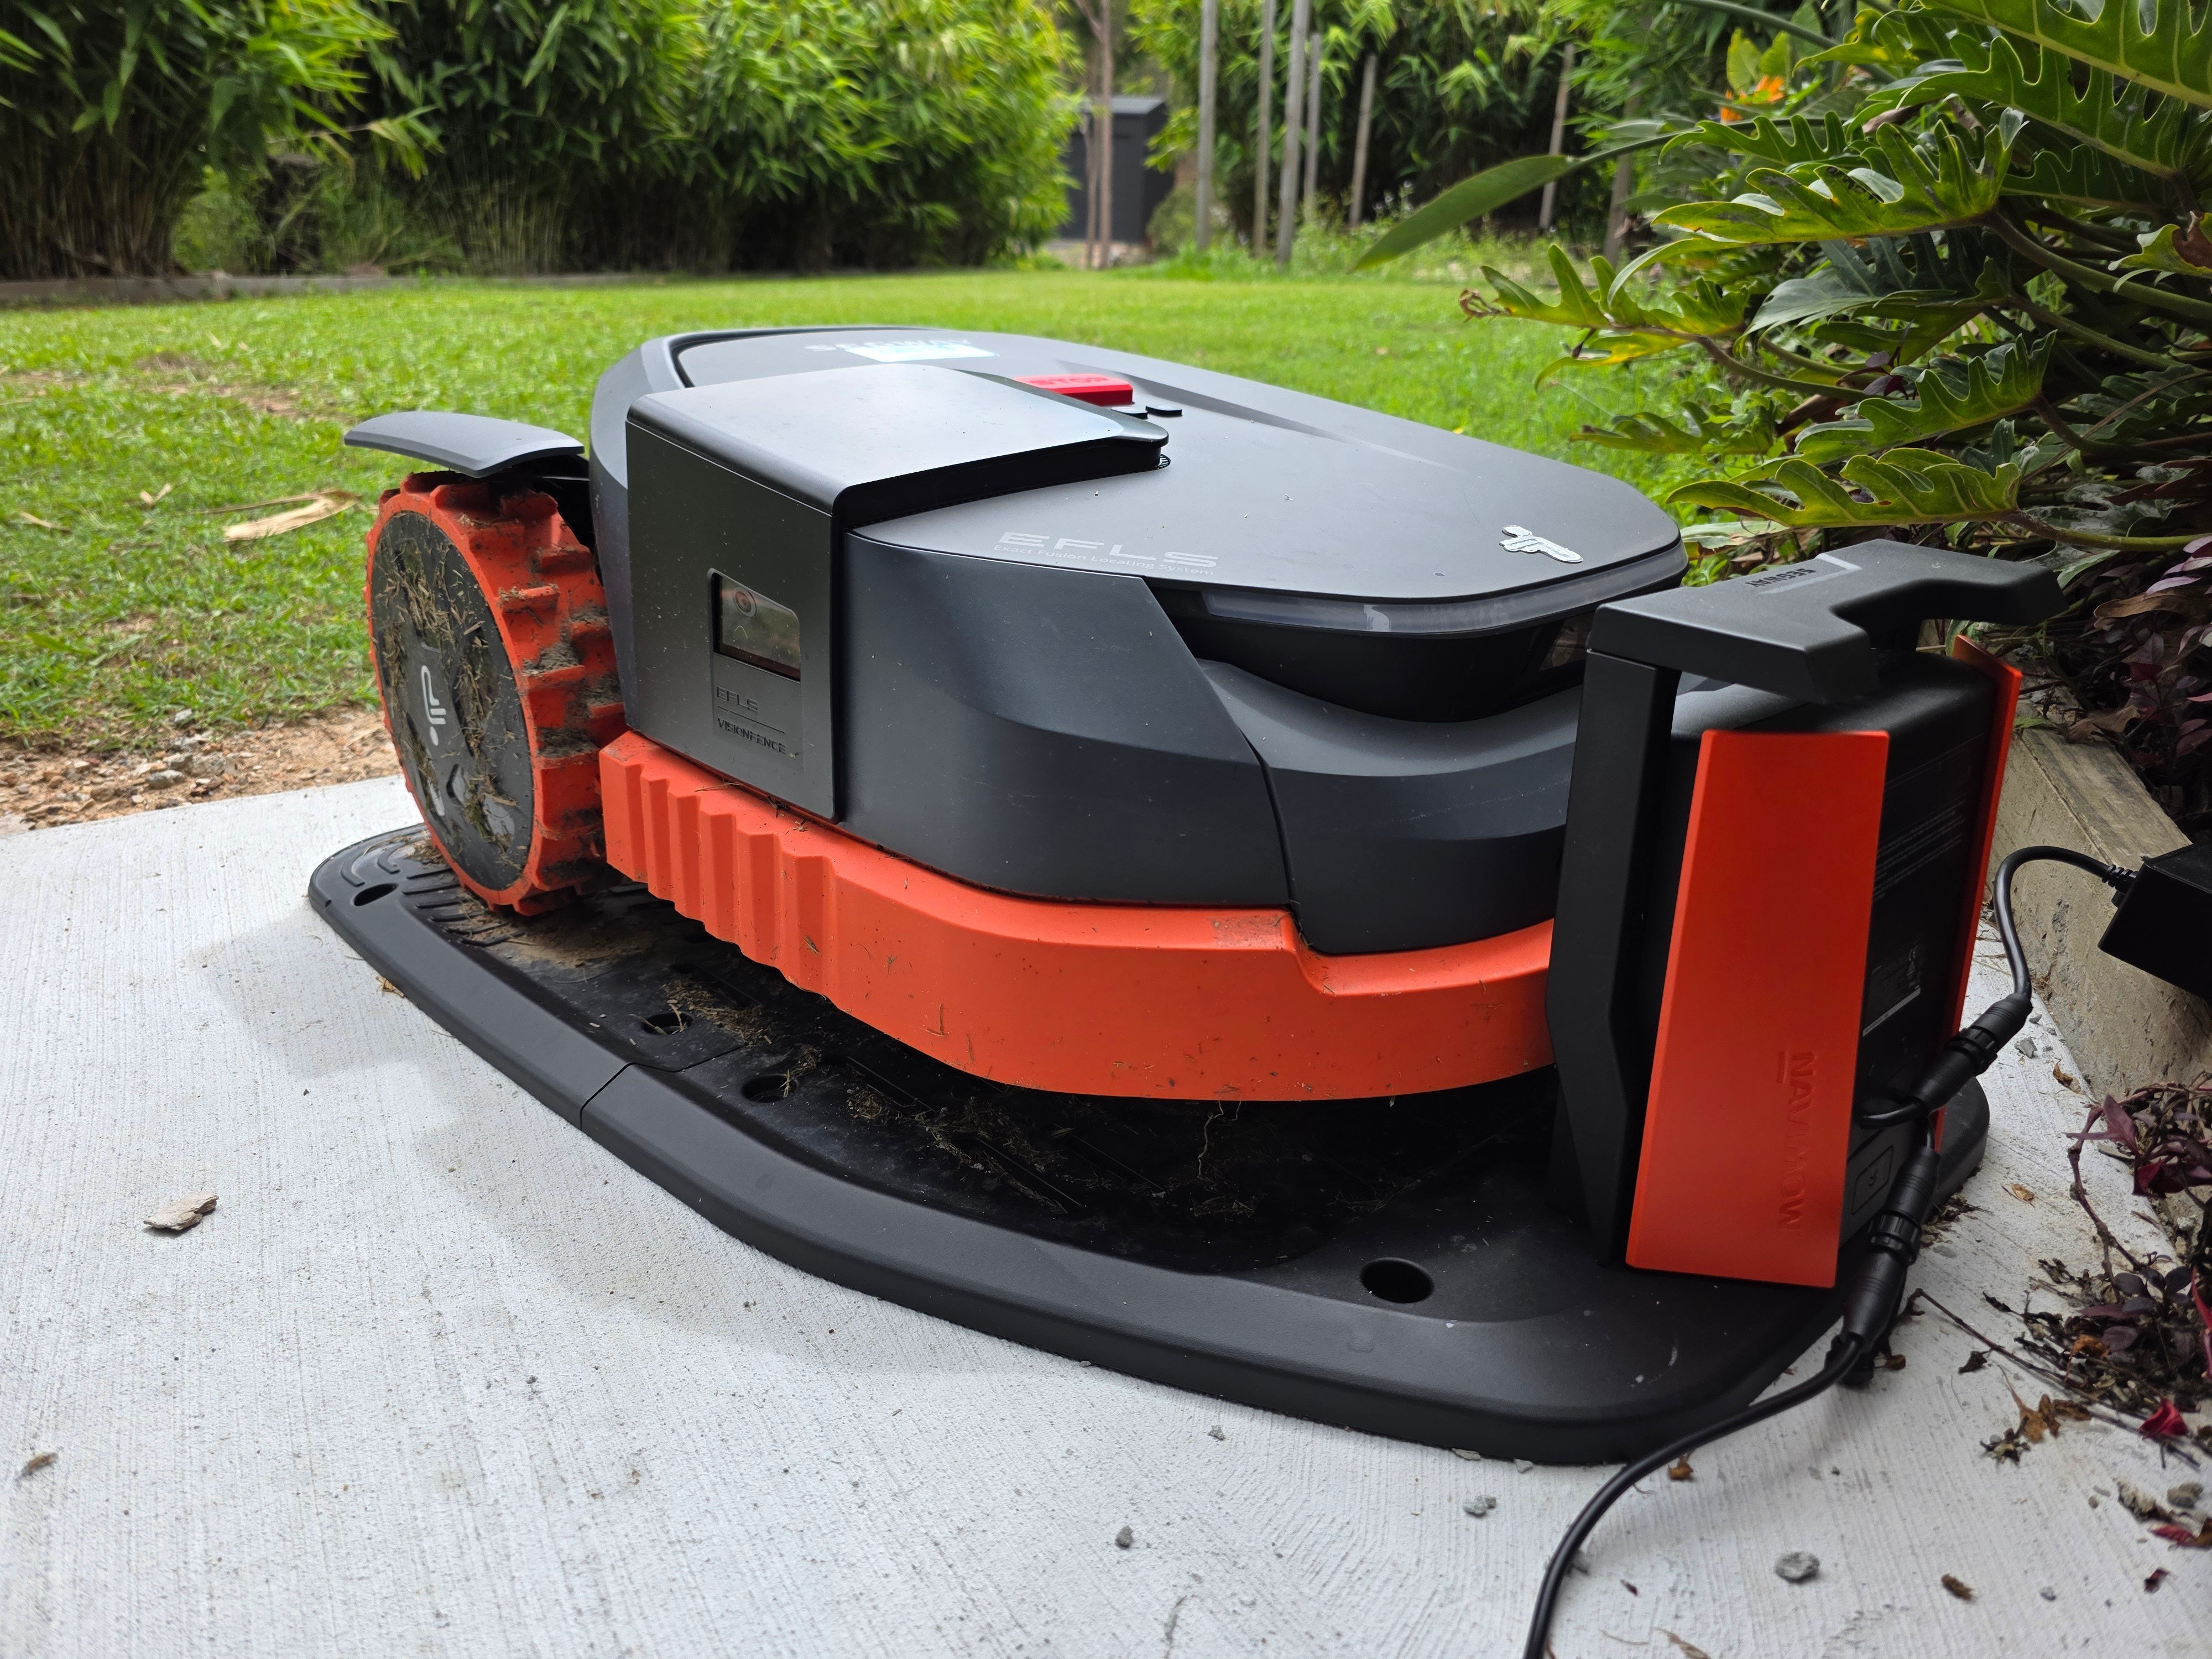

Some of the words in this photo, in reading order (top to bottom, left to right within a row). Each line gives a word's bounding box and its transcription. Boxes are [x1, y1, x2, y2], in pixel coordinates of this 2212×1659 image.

[1028, 376, 1109, 385] STOP
[993, 545, 1034, 555] Exact
[1037, 550, 1087, 560] Fusion
[1091, 556, 1155, 570] Locating
[1159, 564, 1214, 576] System
[999, 531, 1218, 568] EFLS
[1745, 568, 1817, 588] SEGWAY
[716, 685, 759, 712] EFLS
[717, 717, 787, 755] VISIONFENCE
[1777, 1051, 1817, 1230] NAVIMOW
